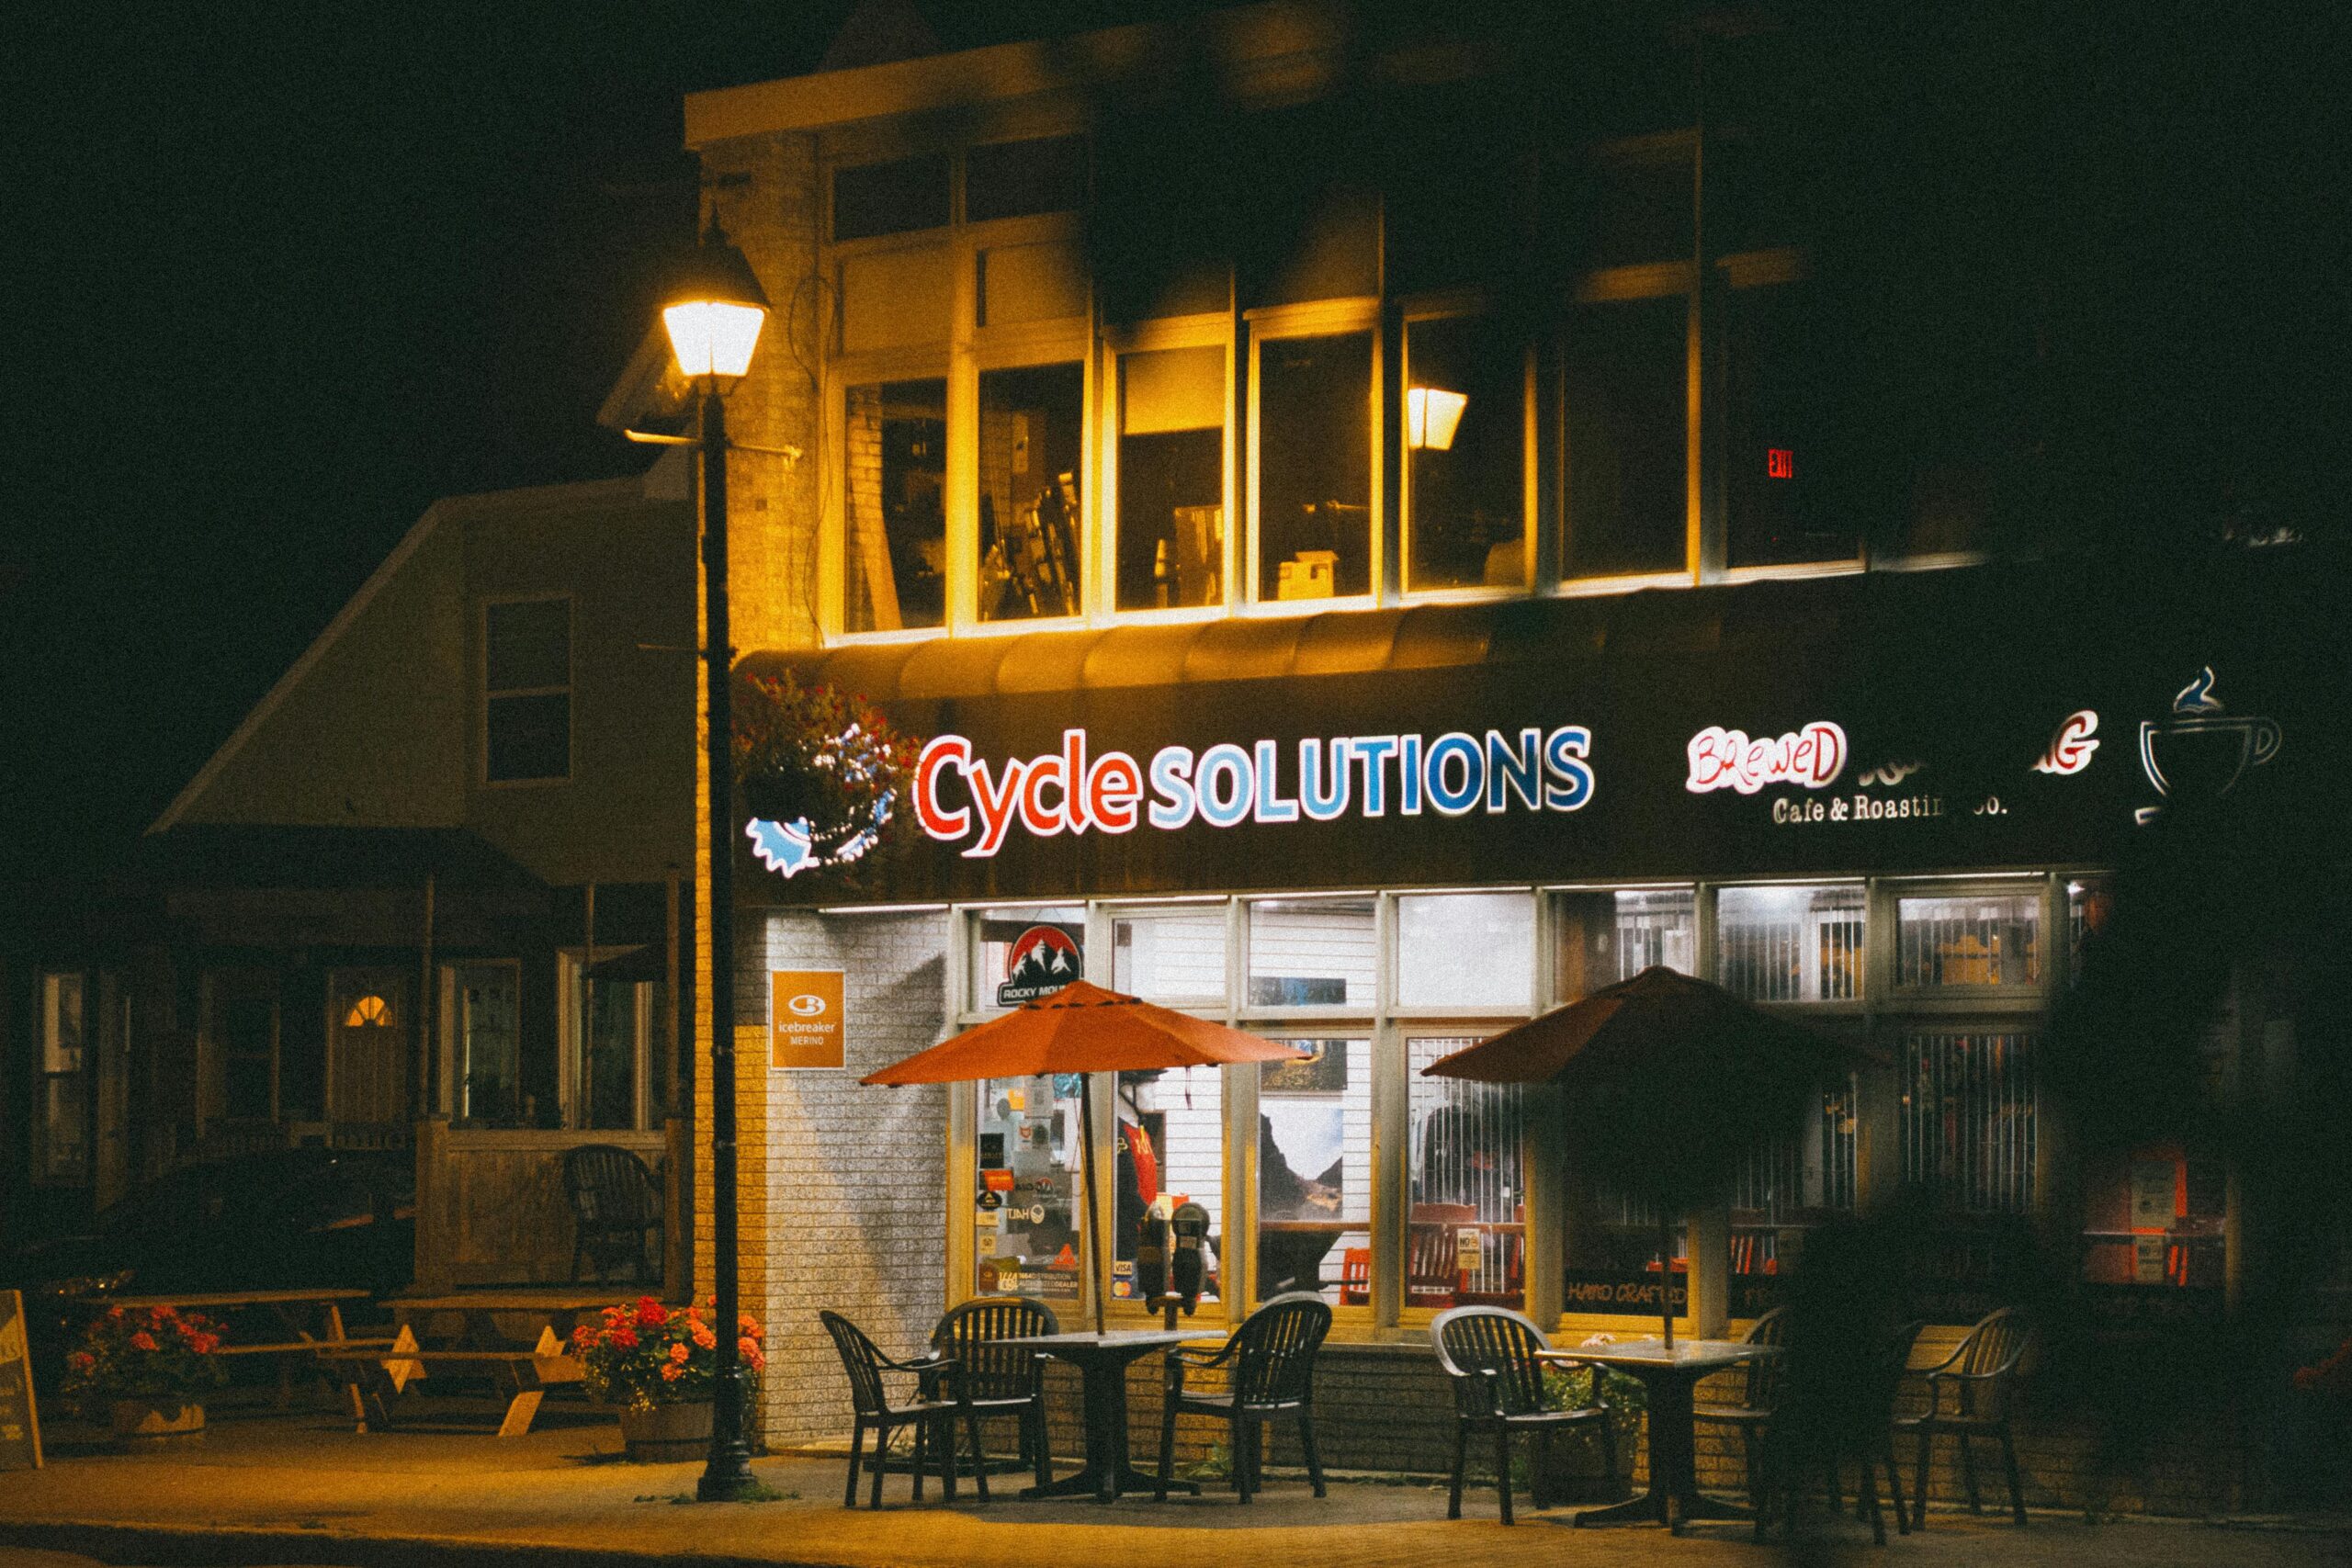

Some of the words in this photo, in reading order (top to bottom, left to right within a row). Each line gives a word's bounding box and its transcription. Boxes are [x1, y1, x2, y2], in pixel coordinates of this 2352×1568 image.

[912, 728, 1144, 857] Cycle
[1149, 726, 1594, 829] SOLUTIONS
[1773, 797, 1825, 824] Cafe
[1830, 797, 1849, 821] &
[1003, 987, 1036, 998] ROCKY
[778, 1021, 835, 1032] icebreaker
[791, 1035, 824, 1045] MERINO
[1115, 1264, 1132, 1272] VISA
